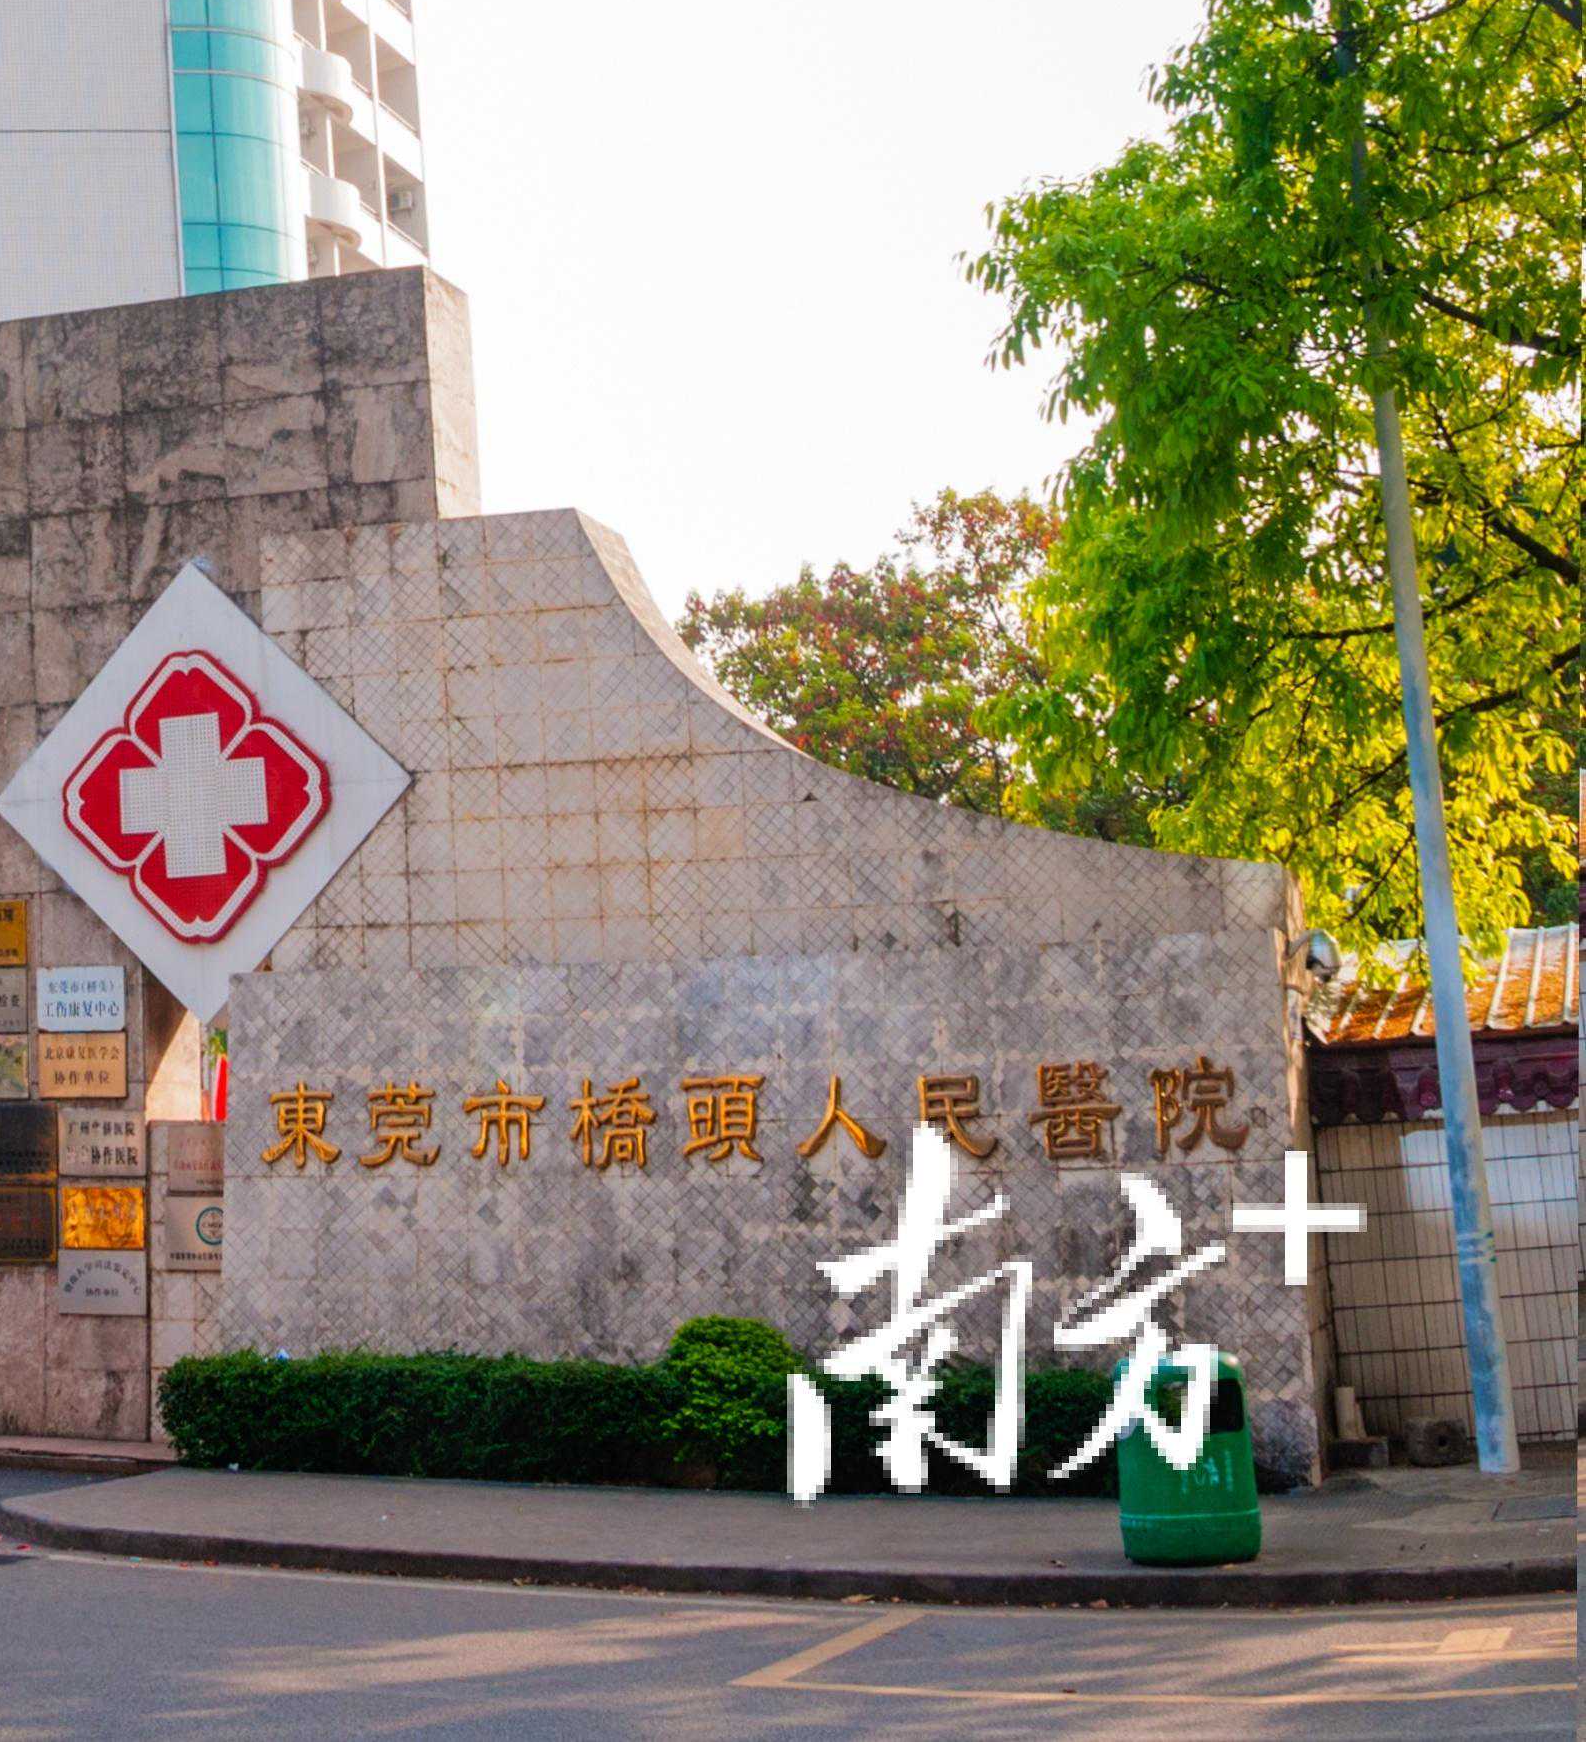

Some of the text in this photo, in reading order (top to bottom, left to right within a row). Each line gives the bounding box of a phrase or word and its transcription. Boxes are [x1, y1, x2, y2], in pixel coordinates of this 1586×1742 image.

[44, 1000, 120, 1018] 工伤康复中心
[262, 1055, 1251, 1171] 東莞市橋頭人民醫院
